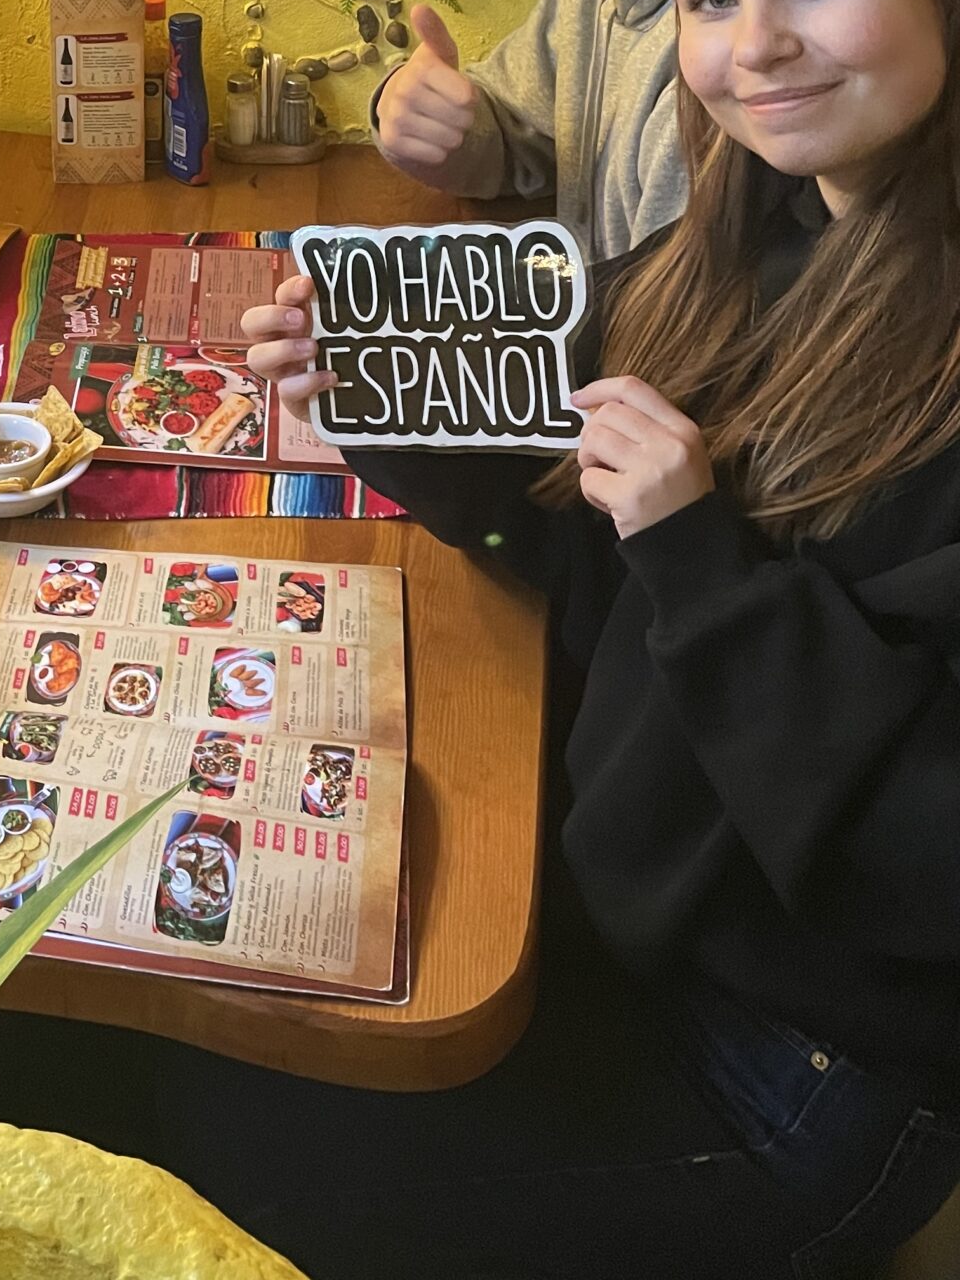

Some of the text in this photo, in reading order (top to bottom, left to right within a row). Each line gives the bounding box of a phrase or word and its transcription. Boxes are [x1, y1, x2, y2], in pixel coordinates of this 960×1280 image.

[86, 305, 100, 326] Lunch
[312, 247, 379, 324] YO
[396, 242, 562, 323] HABLO
[325, 332, 573, 428] ESPAÑOL
